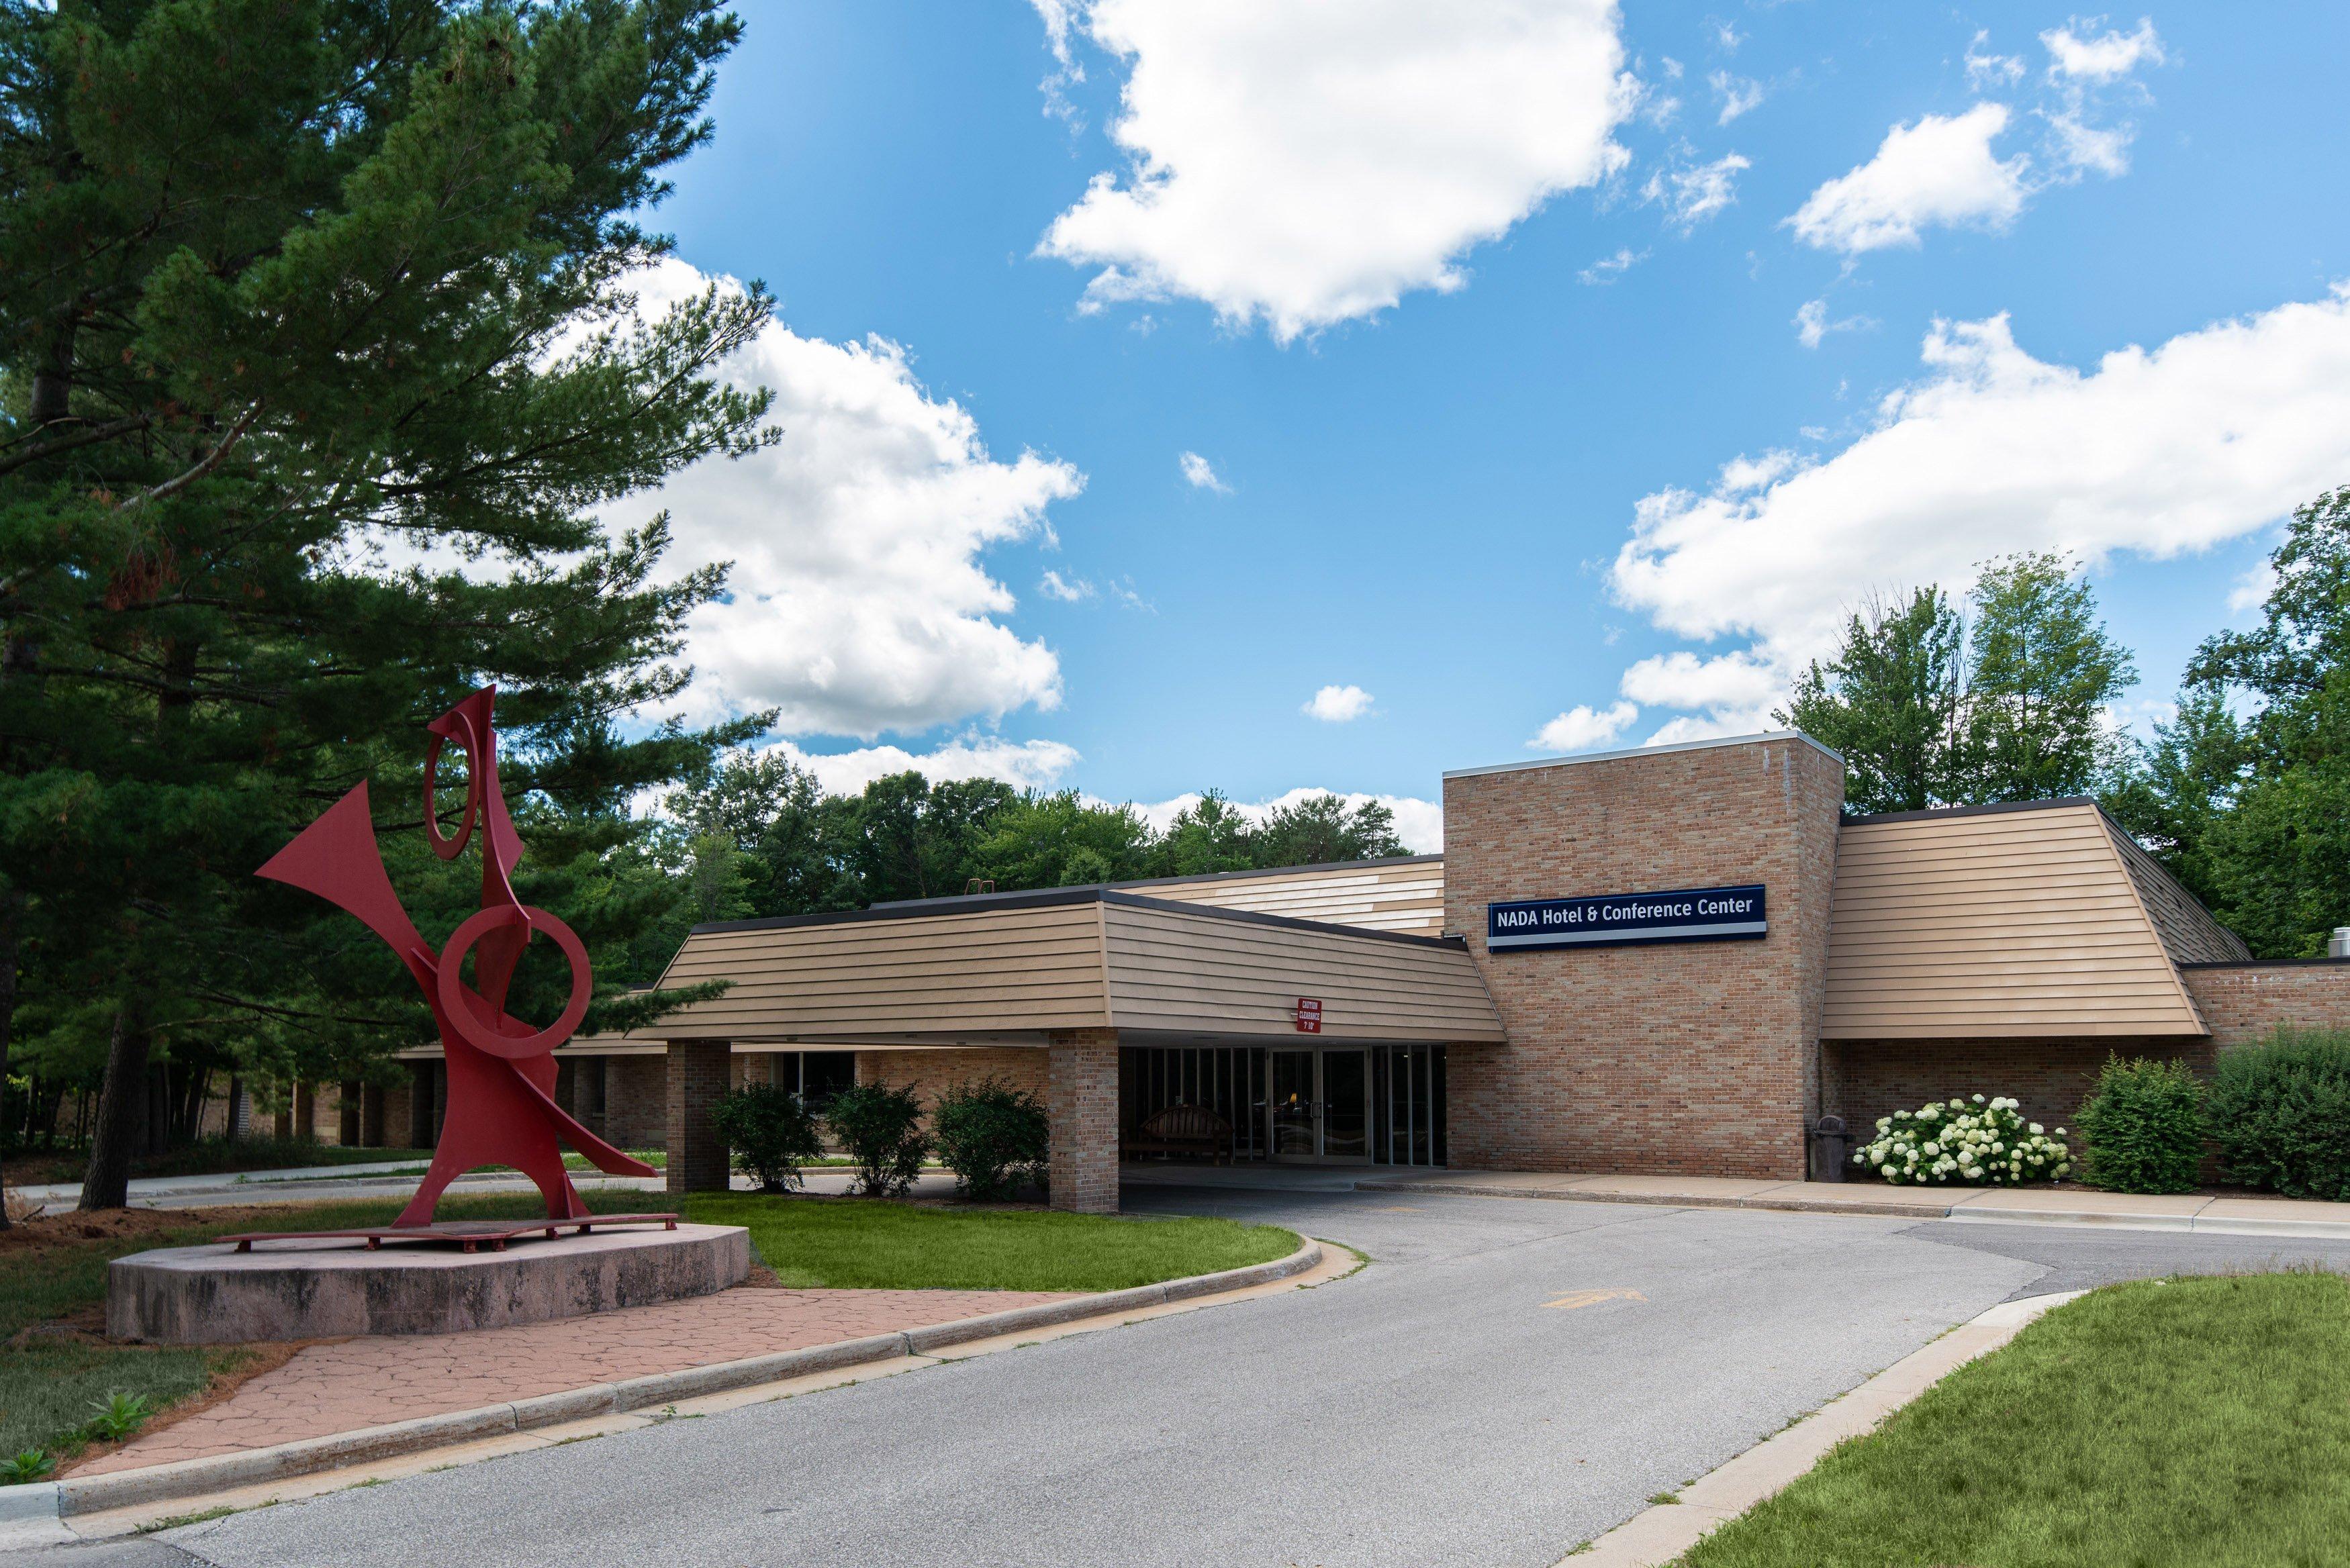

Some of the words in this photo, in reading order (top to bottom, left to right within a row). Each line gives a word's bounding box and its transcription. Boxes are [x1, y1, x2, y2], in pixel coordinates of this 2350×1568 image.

[1498, 910, 1538, 927] NADA
[1543, 906, 1583, 924] Hotel
[1587, 906, 1598, 922] &
[1602, 903, 1692, 921] Conference
[1697, 898, 1753, 915] Center
[1302, 1000, 1318, 1010] CAUTION
[1299, 1010, 1320, 1020] CLEARANCE
